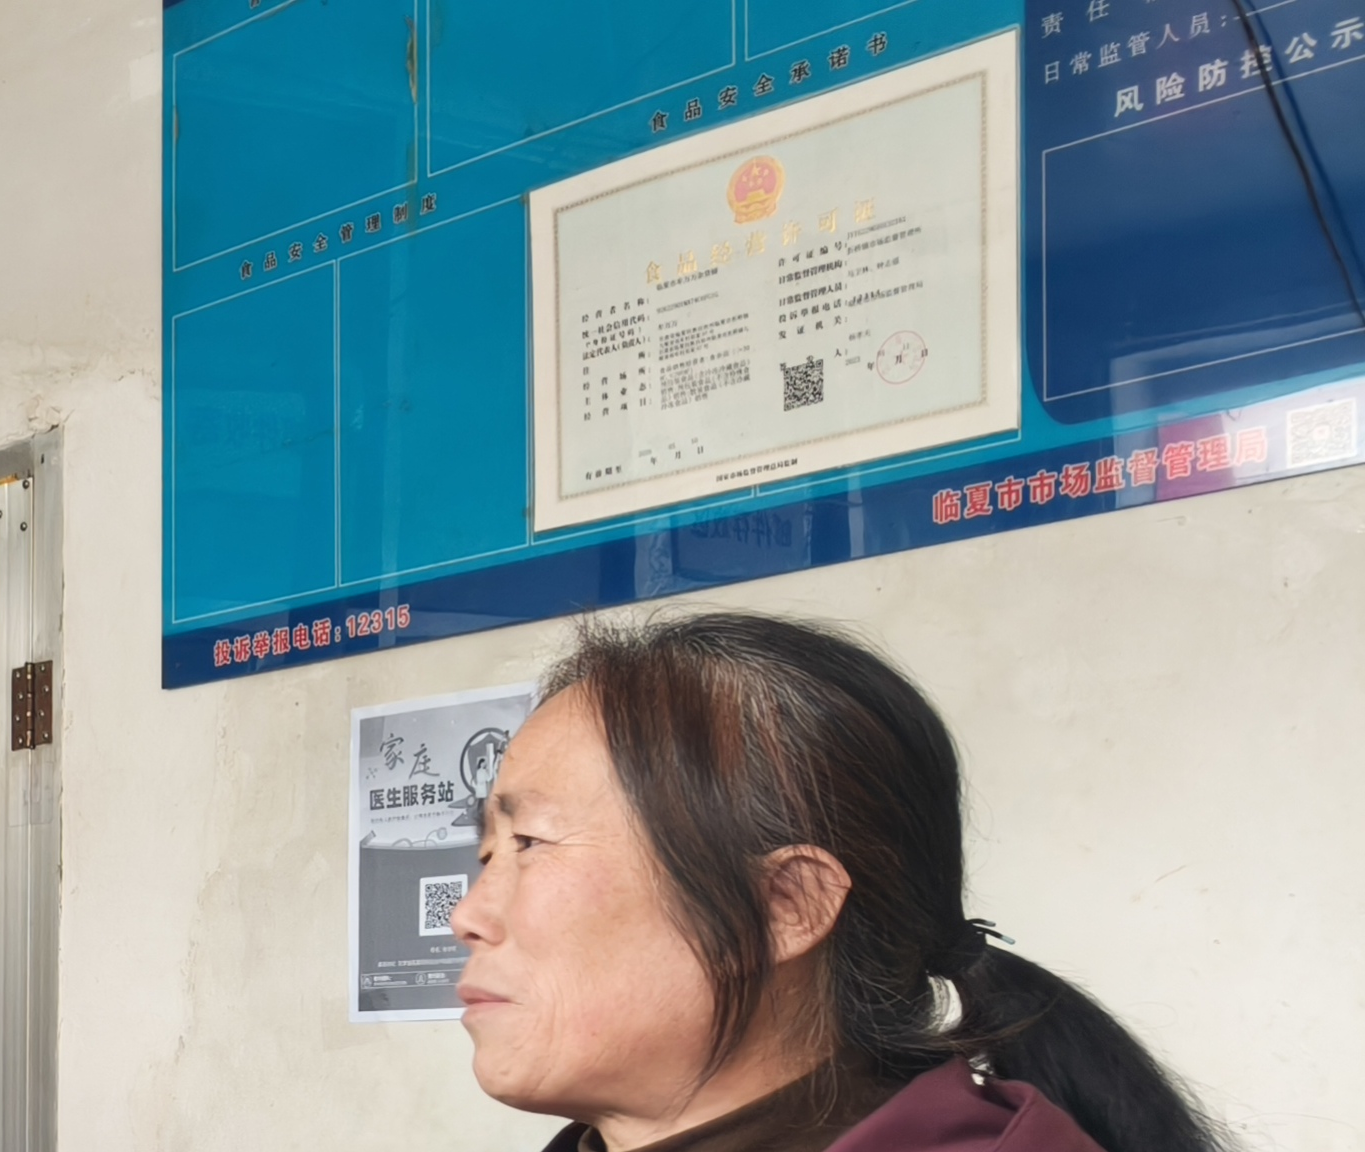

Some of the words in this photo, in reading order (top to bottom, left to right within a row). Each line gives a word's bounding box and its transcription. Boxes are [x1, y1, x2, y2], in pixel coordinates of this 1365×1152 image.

[648, 32, 888, 133] 食品安全承诺书
[1114, 16, 1365, 118] 风险防控公示
[238, 193, 438, 281] 食品安全管理制度
[932, 426, 1268, 525] 临夏市市场监督管理局
[369, 781, 454, 811] 医生服务站
[378, 733, 440, 780] 家庭
